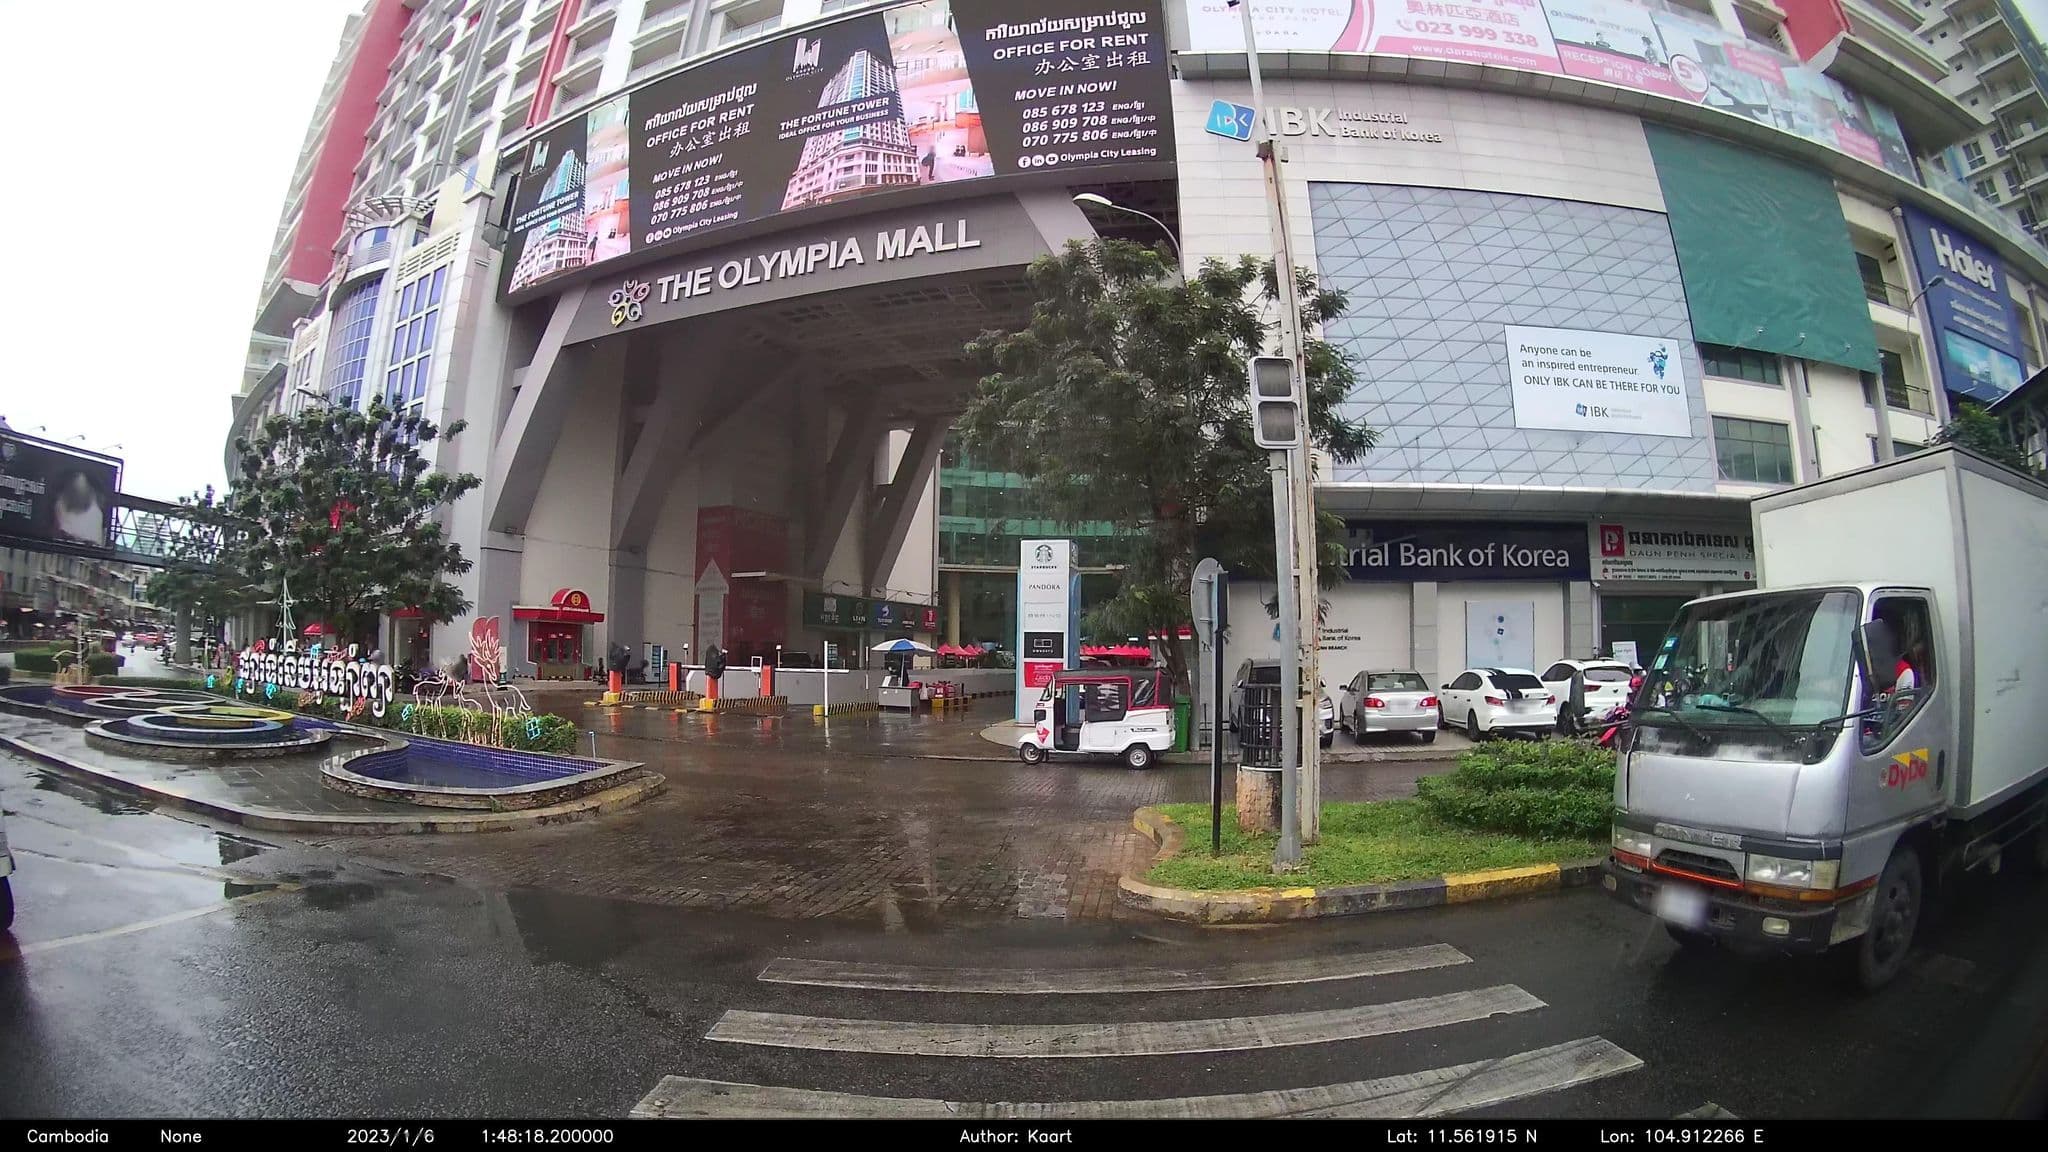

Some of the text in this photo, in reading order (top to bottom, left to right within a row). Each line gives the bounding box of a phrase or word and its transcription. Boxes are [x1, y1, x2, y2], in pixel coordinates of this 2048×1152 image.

[993, 33, 1149, 60] OFFICE FOR RENT
[1415, 20, 1539, 48] 023 999 338
[1035, 50, 1151, 76] 办公室出租
[1014, 80, 1118, 101] MOVE IN NOW!
[780, 97, 889, 131] THE FORTUNE TOWER
[1022, 107, 1048, 119] 085
[1051, 104, 1077, 116] 678
[1081, 101, 1105, 113] 123
[1262, 105, 1337, 138] IBK
[1339, 107, 1408, 125] Industrial
[646, 103, 755, 148] OFFICE FOR RENT
[779, 109, 889, 140] IDEAL OFFICE FOR YOUR BUSINESS
[1022, 121, 1048, 133] 086
[1051, 118, 1078, 130] 909
[1082, 115, 1108, 128] 708
[1341, 125, 1442, 143] Bank of Korea
[669, 121, 751, 158] 办公室出租
[1022, 134, 1048, 147] 070
[1052, 132, 1078, 144] 775
[1081, 129, 1108, 141] 806
[1060, 147, 1157, 162] Olympia City Leasing
[652, 153, 723, 184] MOVE IN NOW!
[652, 199, 670, 212] 086
[671, 193, 690, 206] 909
[691, 187, 711, 201] 708
[655, 186, 672, 199] 085
[673, 180, 692, 194] 678
[694, 175, 711, 187] 123
[650, 212, 669, 226] 070
[670, 205, 688, 219] 775
[689, 200, 709, 214] 806
[672, 211, 739, 234] Olympia City Leasing
[657, 219, 982, 303] THE OLYMPIA MALL
[1930, 228, 1997, 292] Haier
[1520, 344, 1592, 358] Anyone can be
[1521, 359, 1640, 377] an inspired entrepreneur.
[1523, 375, 1680, 395] ONLY IBK CAN BE THERE FOR YOU
[1590, 406, 1609, 418] IBK
[1329, 542, 1570, 568] trial Bank of Korea
[1630, 550, 1662, 558] DAUN
[1666, 551, 1696, 559] PENH
[1887, 758, 1929, 792] DyDo
